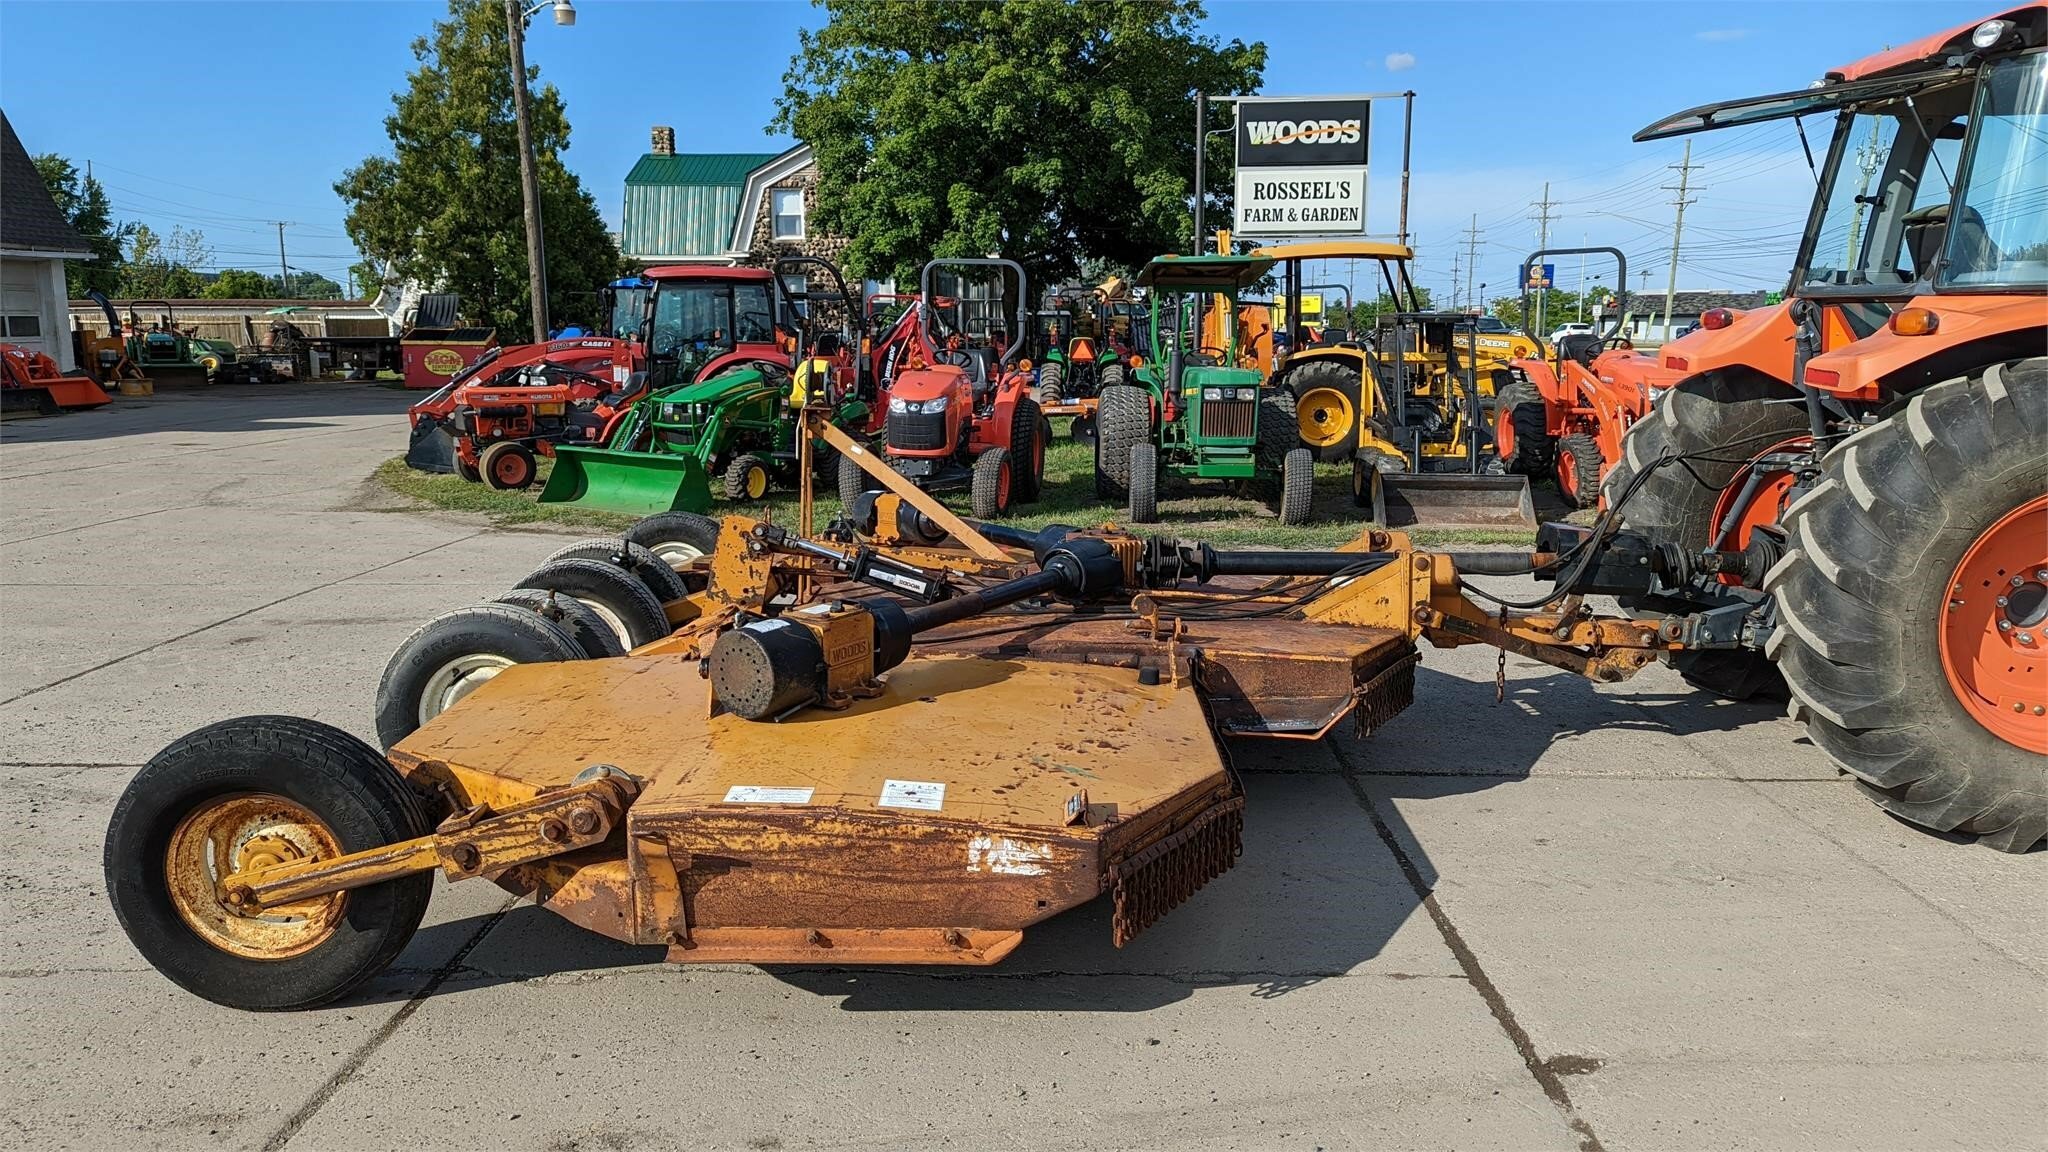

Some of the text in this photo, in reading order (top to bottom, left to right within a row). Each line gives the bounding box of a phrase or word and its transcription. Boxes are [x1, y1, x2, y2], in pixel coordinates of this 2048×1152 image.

[1246, 119, 1361, 145] WOODS
[1253, 181, 1351, 201] ROSSEEL'S
[1244, 207, 1359, 223] FARM & GARDEN
[1480, 338, 1511, 349] DEERE
[832, 640, 867, 662] WOODS
